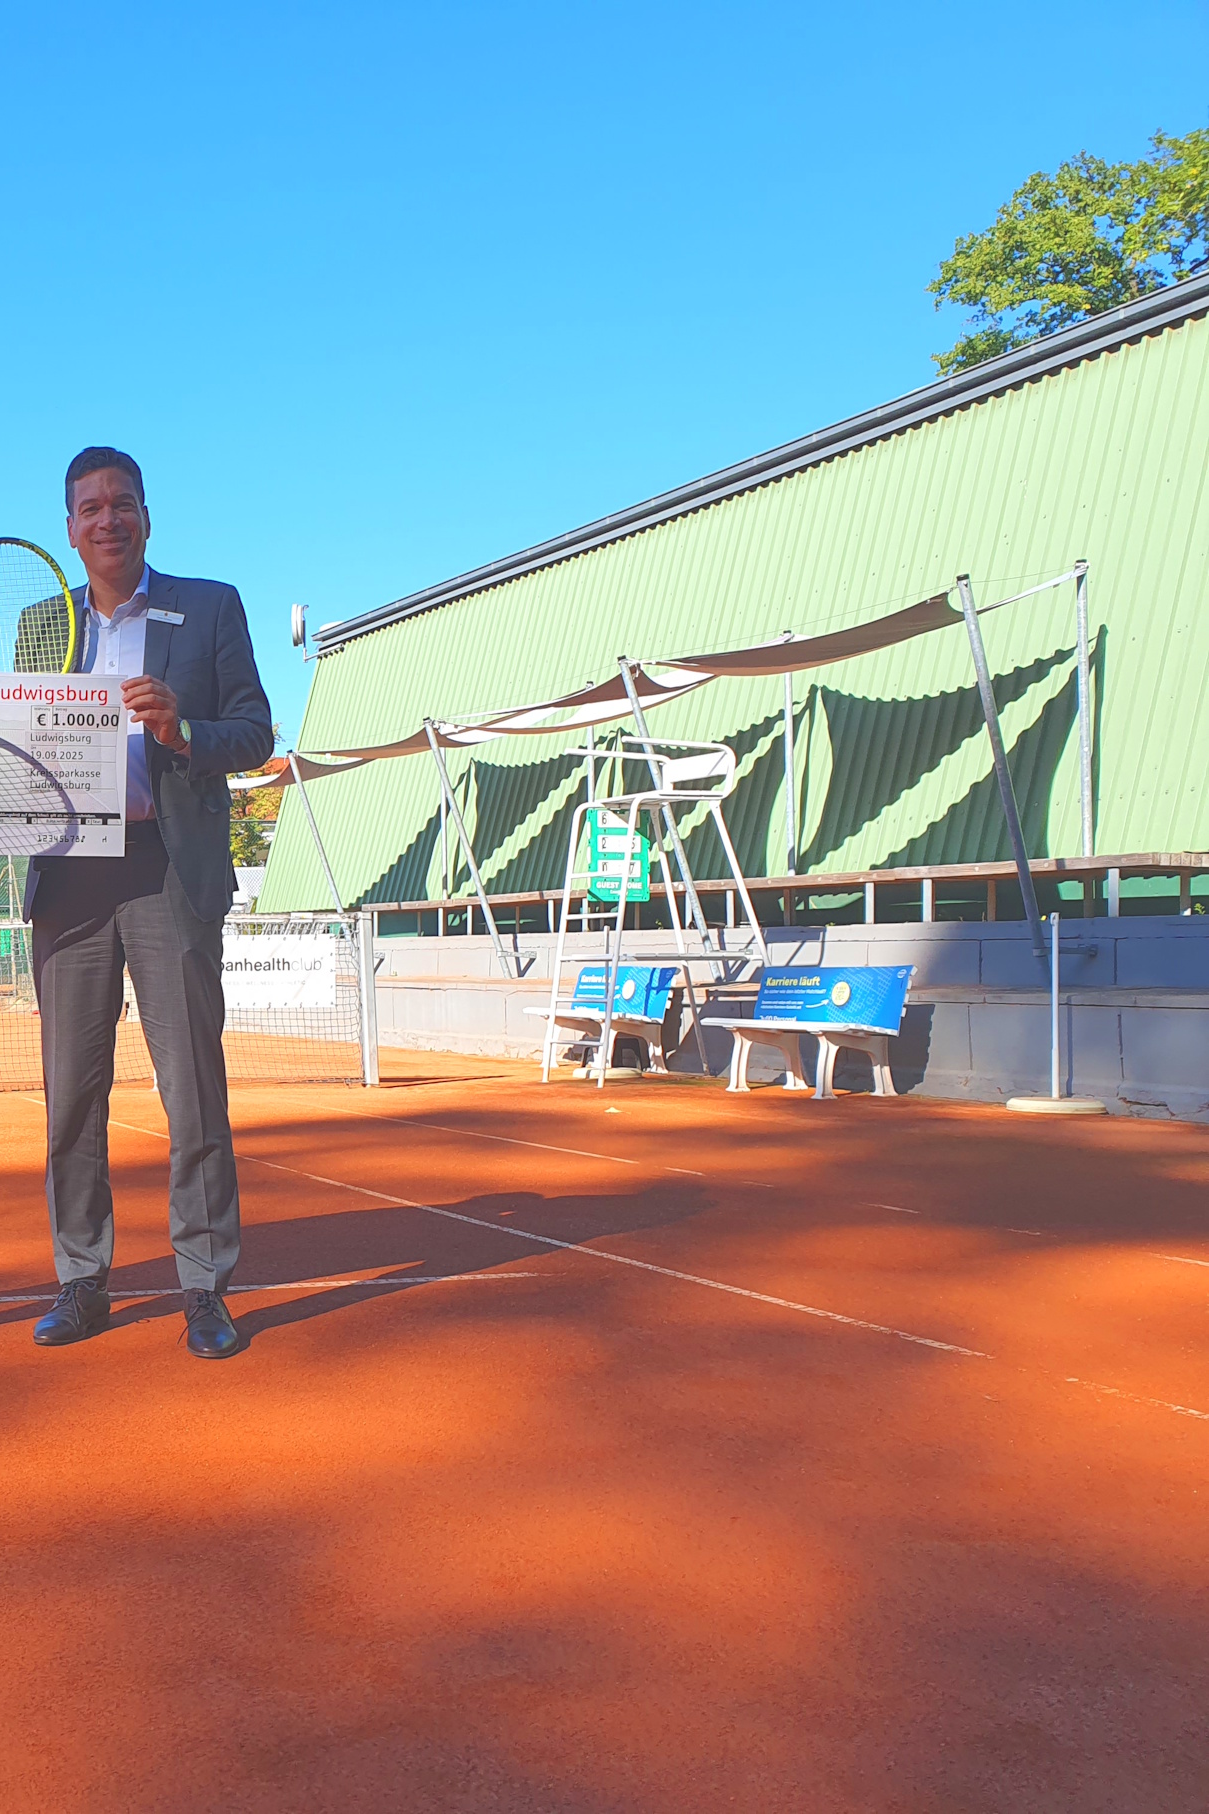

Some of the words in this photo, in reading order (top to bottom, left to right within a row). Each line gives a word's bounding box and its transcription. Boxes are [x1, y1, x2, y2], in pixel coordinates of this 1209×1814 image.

[37, 713, 47, 727] €
[53, 713, 119, 729] 1.000,00
[30, 733, 92, 744] Ludwigsburg
[31, 750, 84, 761] 19.09.2025
[30, 768, 101, 779] Kreissparkasse
[30, 780, 91, 791] Ludwigsburg
[766, 976, 799, 987] Karriere
[799, 975, 821, 986] läuft
